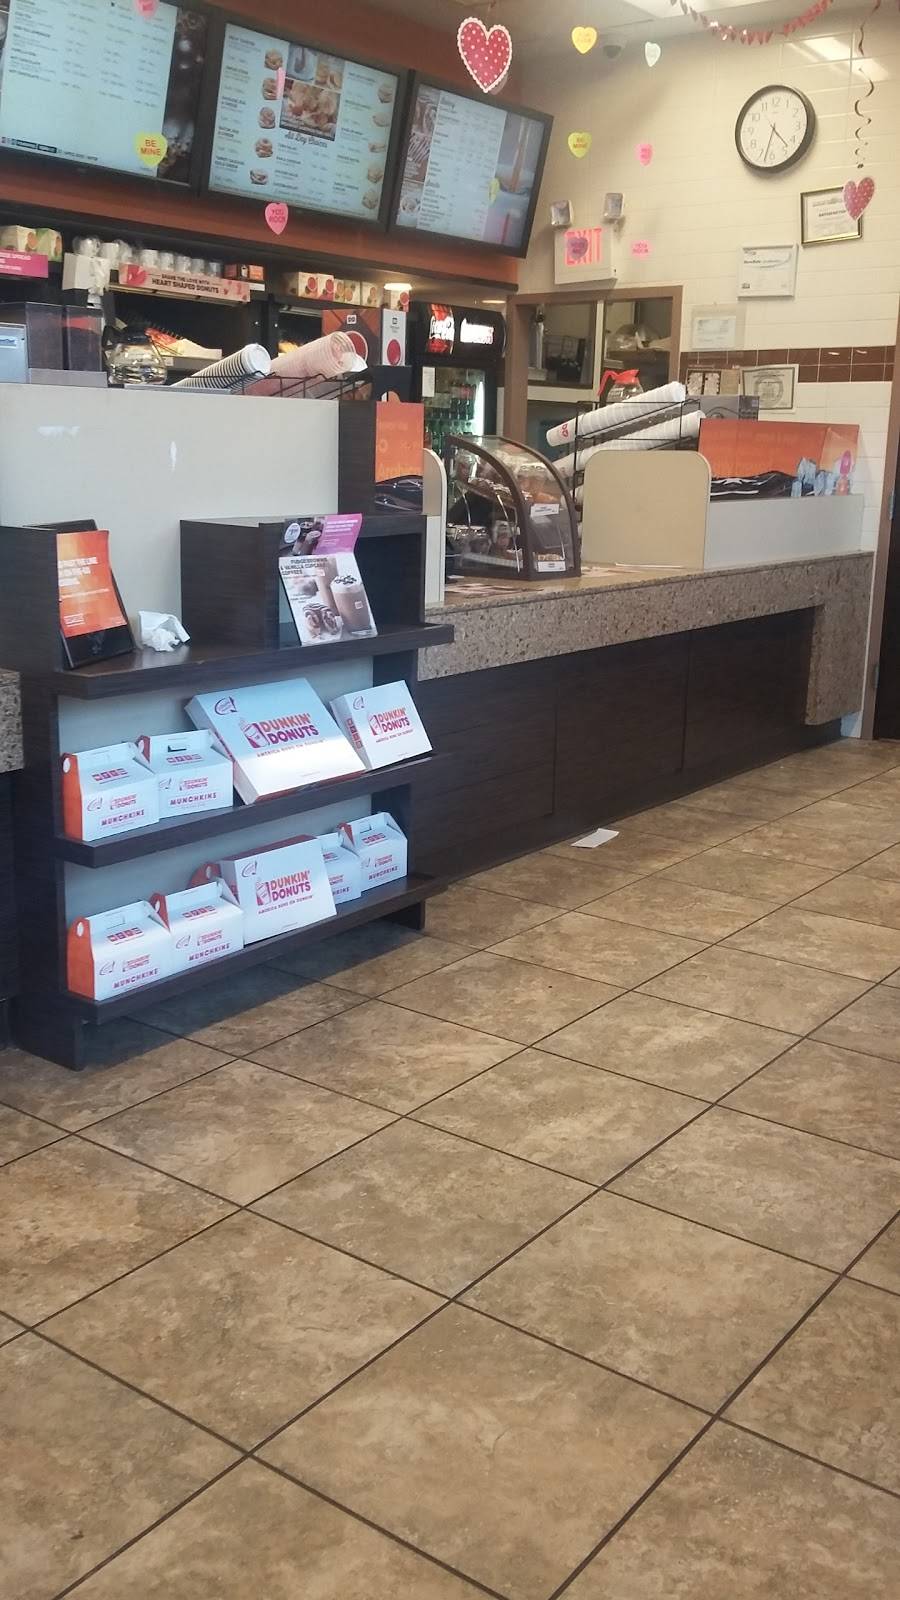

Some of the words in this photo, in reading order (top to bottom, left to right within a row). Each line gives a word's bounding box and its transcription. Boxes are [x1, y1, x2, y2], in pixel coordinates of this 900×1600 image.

[145, 139, 157, 147] BE
[140, 147, 161, 156] MINE
[152, 278, 171, 287] HEART
[172, 282, 195, 290] SHAPED
[196, 285, 219, 294] DONUTS
[259, 713, 311, 733] DUNKIN'
[377, 707, 407, 723] DUNKIN'
[381, 717, 411, 733] DONUTS
[267, 724, 320, 745] DONUTS
[169, 792, 217, 806] MUNCHKINS
[100, 809, 145, 826] MUNCHKINS
[270, 869, 311, 891] DUNKIN'
[368, 865, 399, 881] MUNCHKINS
[271, 881, 312, 902] DONUTS
[188, 942, 231, 961] MUNCHKINS
[112, 967, 159, 989] MUNCHKINS
